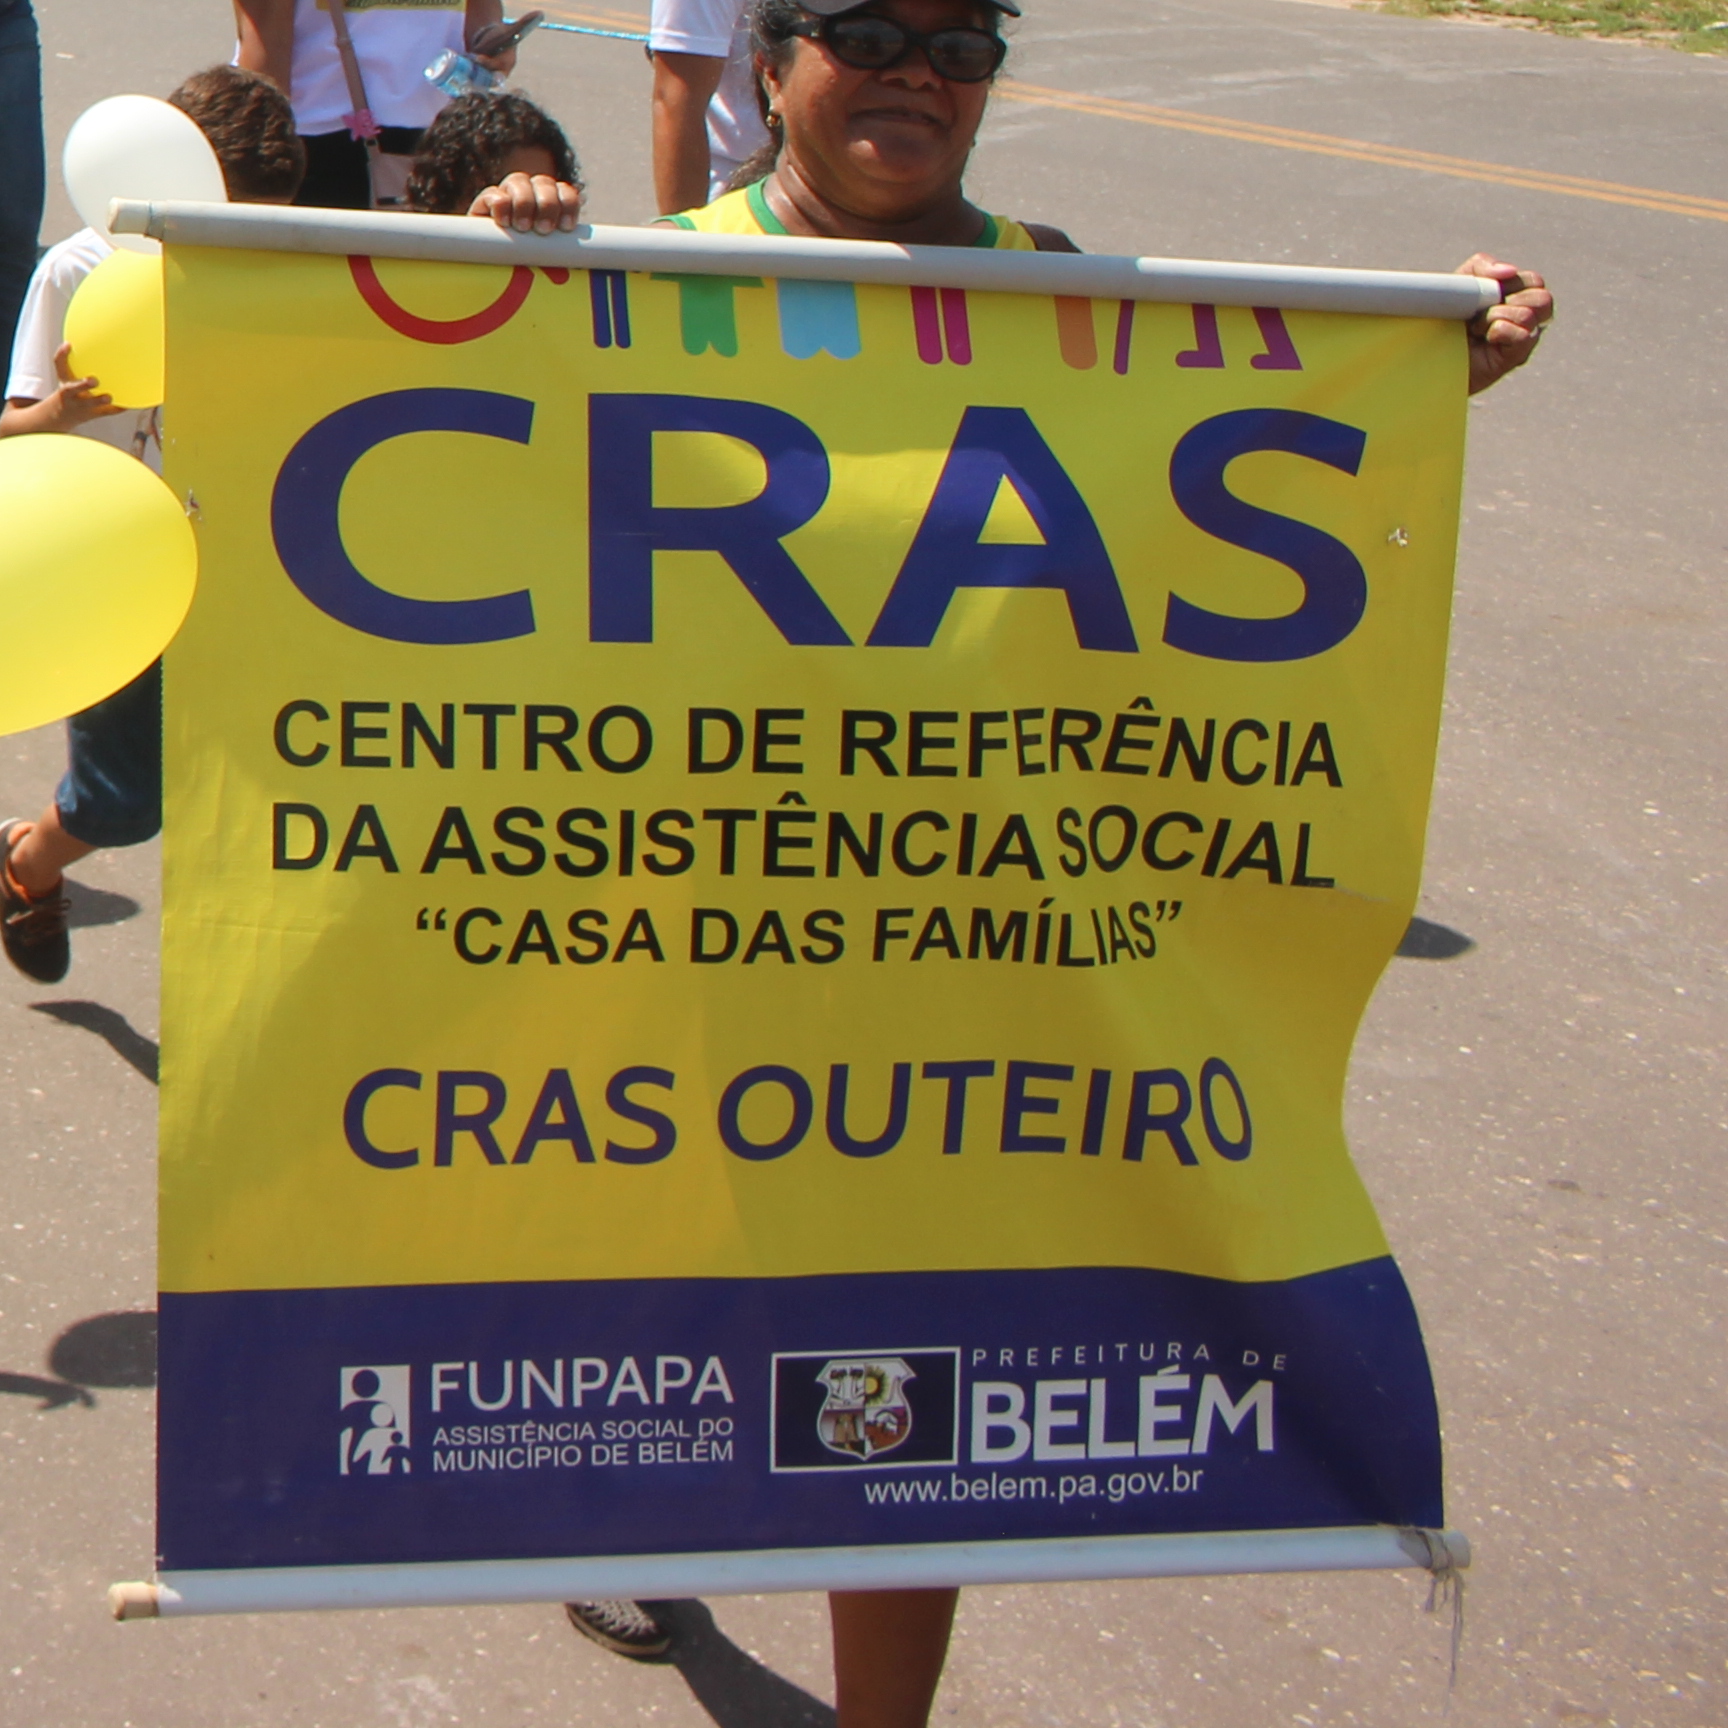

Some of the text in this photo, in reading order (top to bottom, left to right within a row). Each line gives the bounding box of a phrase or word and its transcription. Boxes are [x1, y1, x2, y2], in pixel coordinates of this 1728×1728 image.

[270, 385, 1368, 663] CRAS
[272, 696, 1344, 788] CENTRO DE REFERÊNCIA
[271, 790, 1336, 889] DA ASSISTÊNCIA SOCIAL
[687, 908, 847, 965] DAS
[343, 1056, 1253, 1170] CRAS OUTEIRO
[972, 1342, 1290, 1371] PREFEITURA DE
[430, 1355, 1277, 1465] FUNPAPA BELÉM
[433, 1417, 734, 1446] ASSISTÊNCIA SOCIAL DO
[433, 1437, 734, 1473] MUNICÍPIO DE BELÉM
[863, 1468, 1204, 1508] www.belem.pa.gov.br
